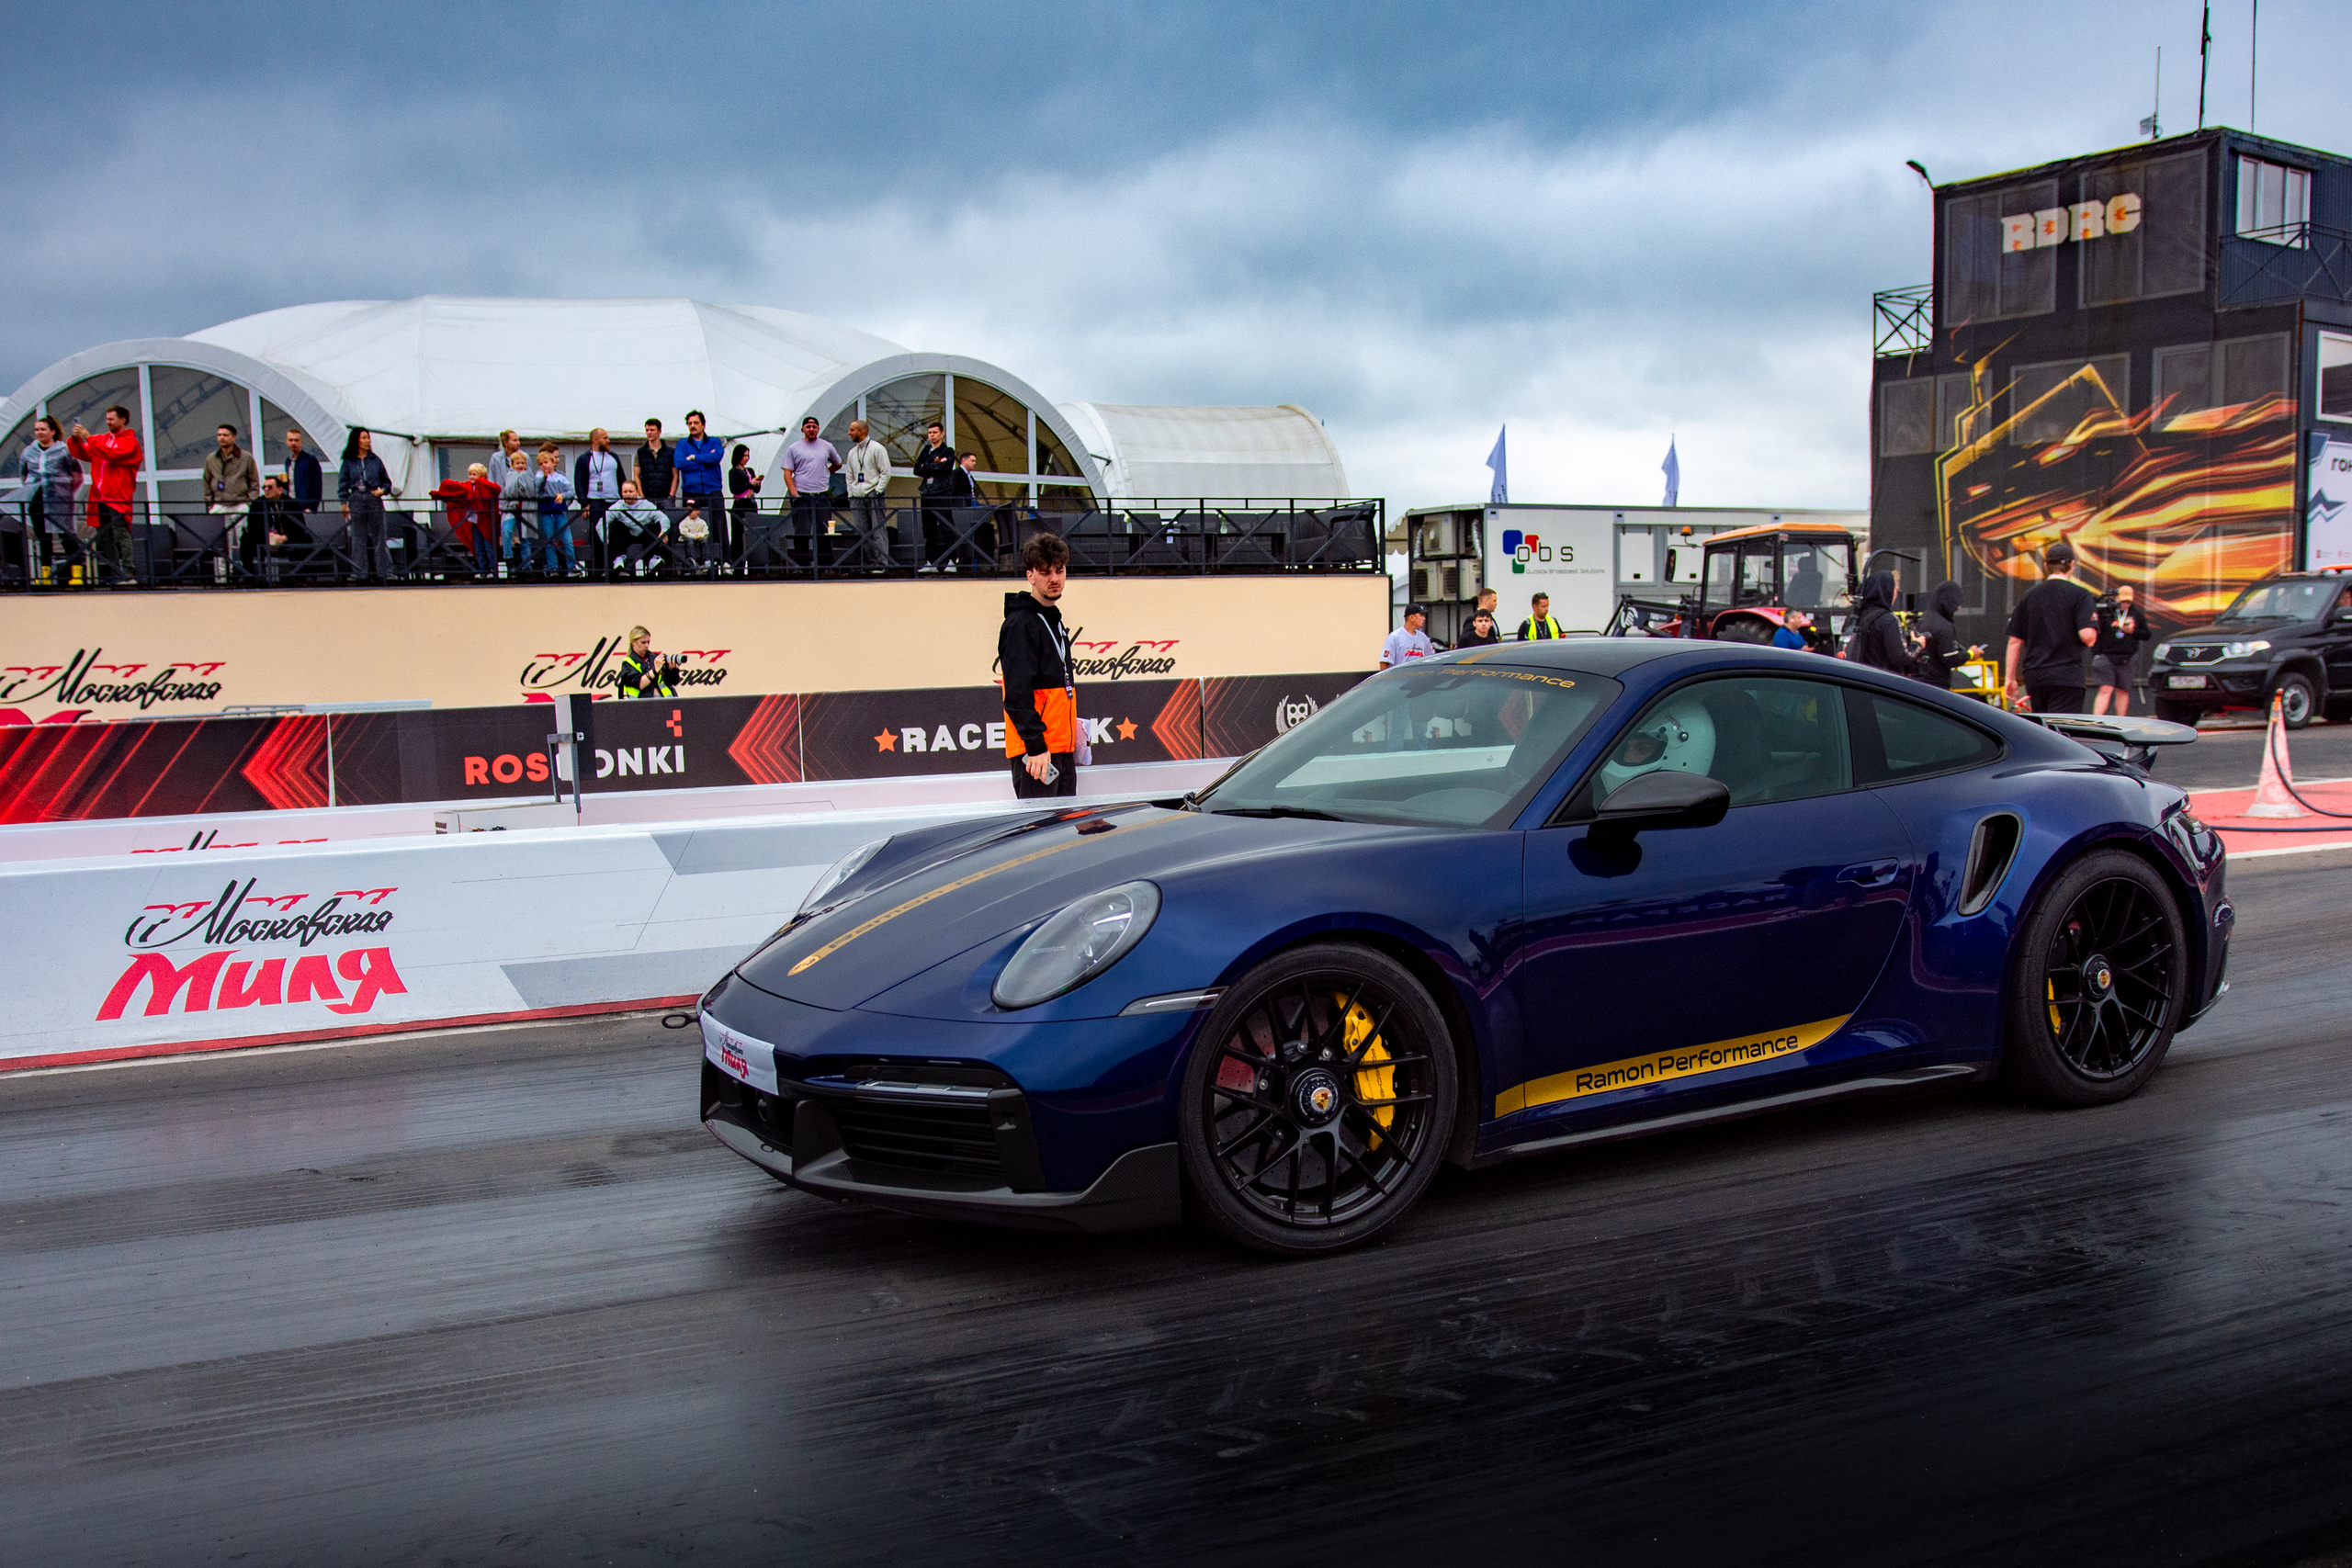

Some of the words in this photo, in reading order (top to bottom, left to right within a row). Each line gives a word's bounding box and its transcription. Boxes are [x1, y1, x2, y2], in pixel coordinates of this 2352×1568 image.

[2001, 192, 2142, 254] RDRC
[0, 638, 222, 710] Московская
[1437, 669, 1575, 689] Performance
[464, 745, 684, 785] ROSONKI
[124, 877, 394, 949] Московская
[96, 947, 408, 1021] Миля
[1576, 1060, 1655, 1093] Ramon
[1658, 1034, 1798, 1076] Performance
